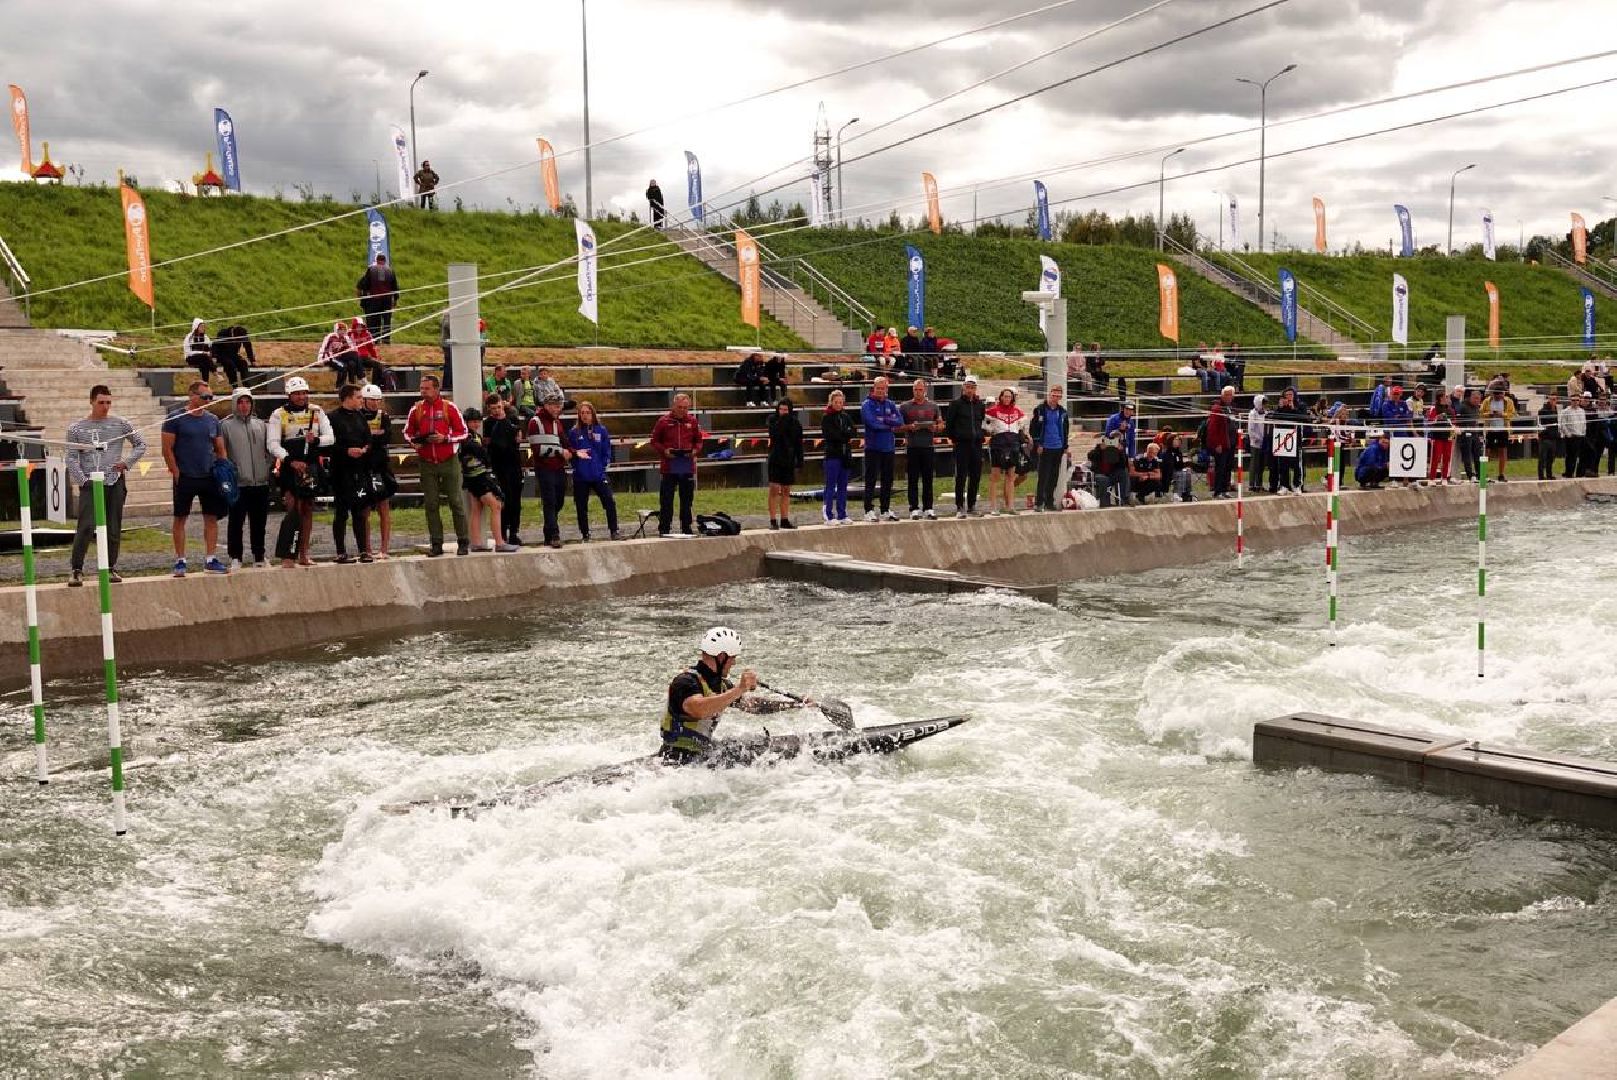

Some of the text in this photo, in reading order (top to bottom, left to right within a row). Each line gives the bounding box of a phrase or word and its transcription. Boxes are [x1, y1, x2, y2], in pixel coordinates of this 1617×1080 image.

[1274, 432, 1294, 453] 10
[1401, 443, 1415, 471] 9
[52, 467, 60, 512] 8
